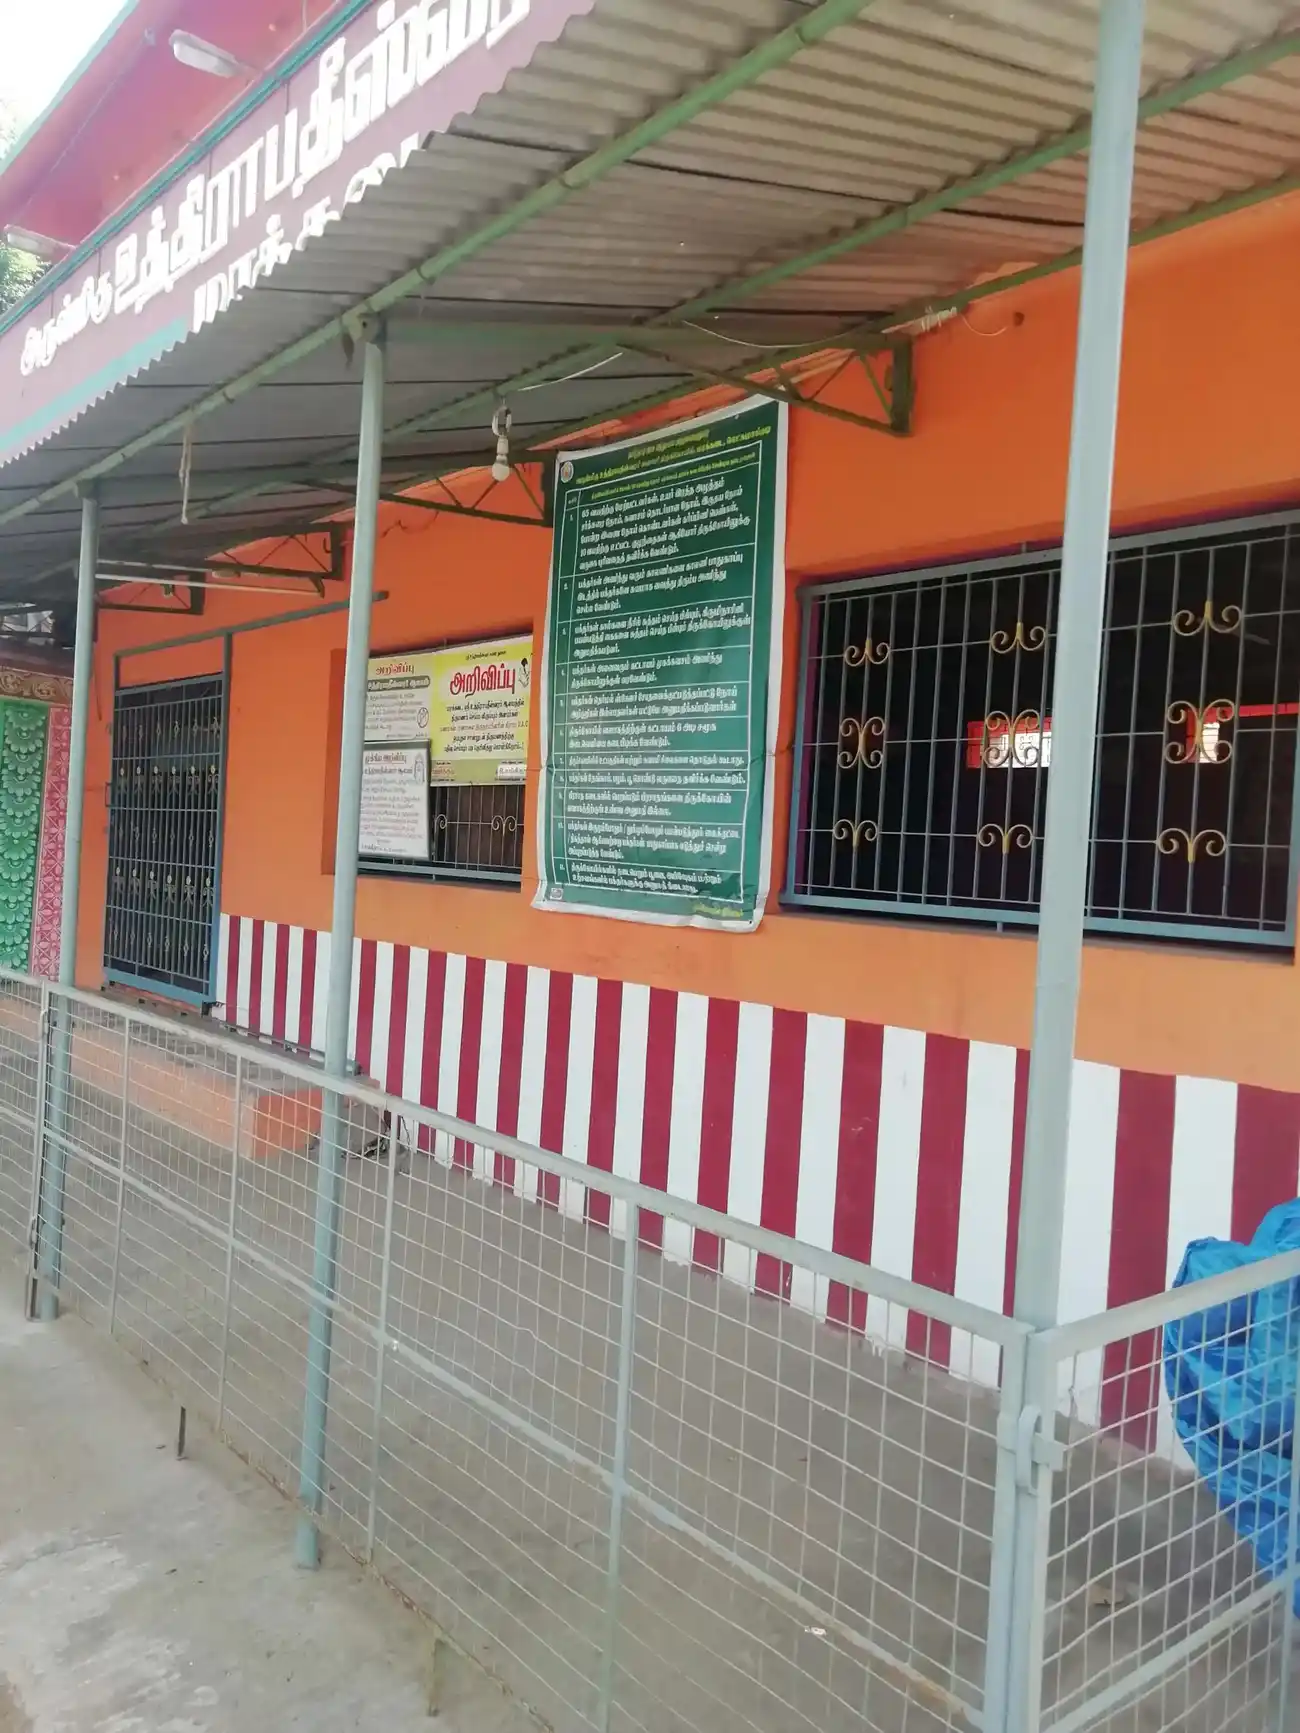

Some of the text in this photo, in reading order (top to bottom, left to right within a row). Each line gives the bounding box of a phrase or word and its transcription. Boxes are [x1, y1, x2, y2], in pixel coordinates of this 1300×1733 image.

[581, 509, 589, 517] 65
[376, 662, 414, 675] அறிவிப்பு
[450, 663, 515, 698] அறிவிப்பு
